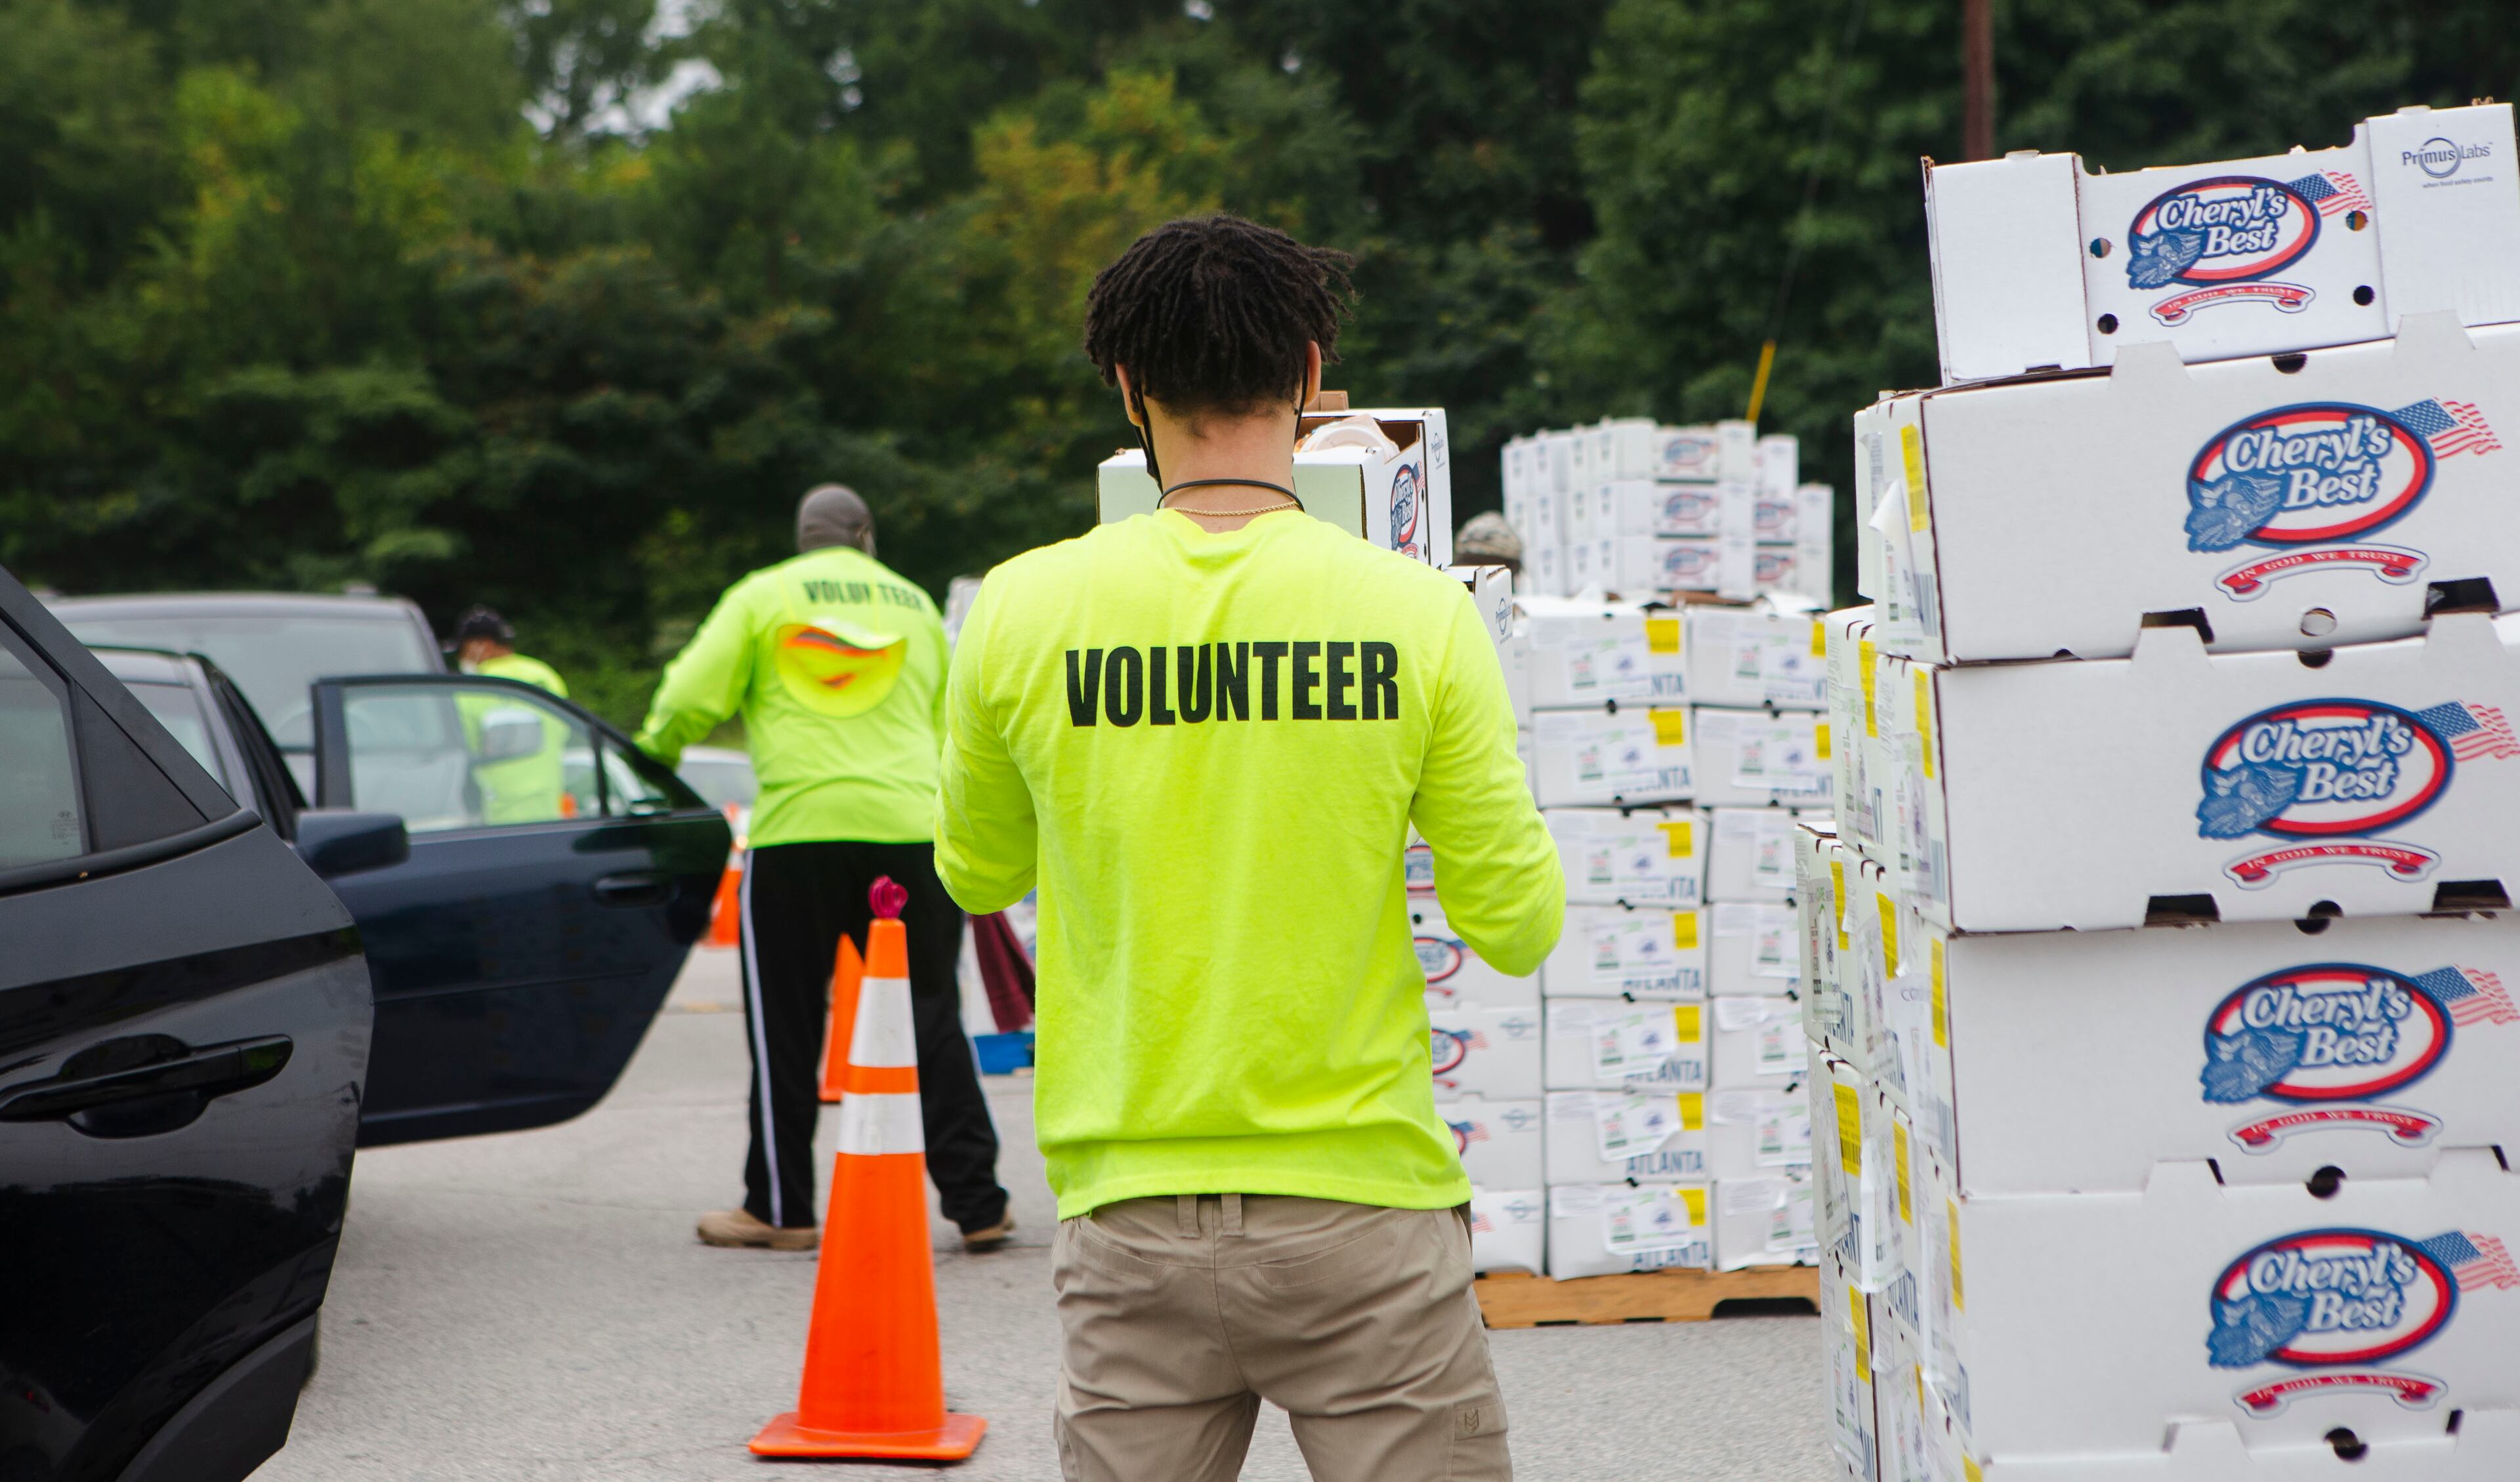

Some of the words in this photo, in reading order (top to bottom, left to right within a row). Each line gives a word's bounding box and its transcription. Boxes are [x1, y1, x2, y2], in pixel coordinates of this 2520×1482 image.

[2158, 188, 2288, 229] Cheryl's
[2204, 220, 2277, 256] Best
[2252, 286, 2294, 297] TRUST
[2226, 419, 2392, 470] Cheryl's
[1395, 472, 1414, 505] Cheryl's
[2283, 461, 2378, 507] Best
[1401, 501, 1413, 524] Best
[2236, 566, 2256, 581] IN
[2263, 556, 2304, 571] GOD
[2310, 550, 2340, 562] WE
[2345, 550, 2403, 564] TRUST
[1065, 642, 1398, 728] VOLUNTEER
[2243, 716, 2412, 765] Cheryl's
[2298, 758, 2397, 801] Best
[2246, 855, 2267, 869] IN
[2244, 979, 2410, 1033] Cheryl's
[2300, 1024, 2396, 1066] Best
[2250, 1243, 2418, 1297] Cheryl's
[2307, 1288, 2401, 1330] Best
